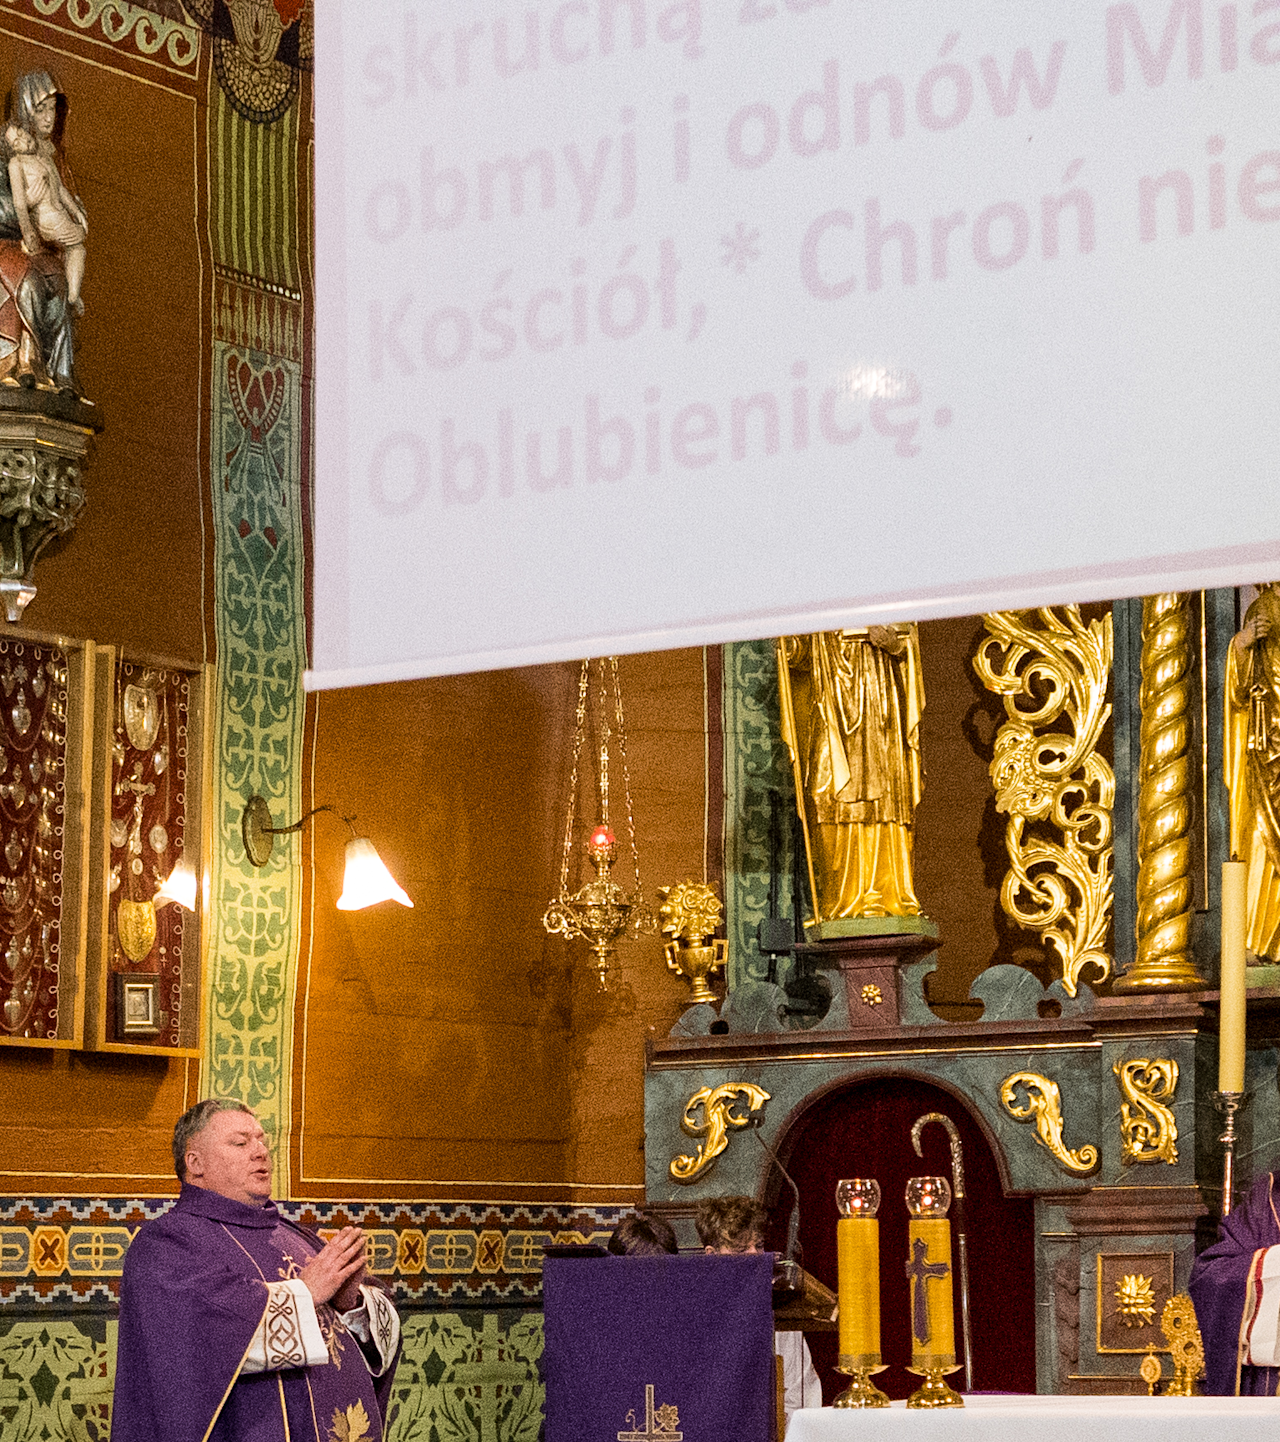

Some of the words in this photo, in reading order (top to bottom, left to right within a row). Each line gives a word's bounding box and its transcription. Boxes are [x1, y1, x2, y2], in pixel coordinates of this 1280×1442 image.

[367, 105, 638, 245] obmyj
[673, 93, 692, 183] i
[725, 30, 1067, 171] odnów
[799, 158, 1096, 301] Chroń
[366, 360, 954, 518] Oblubienicę.
